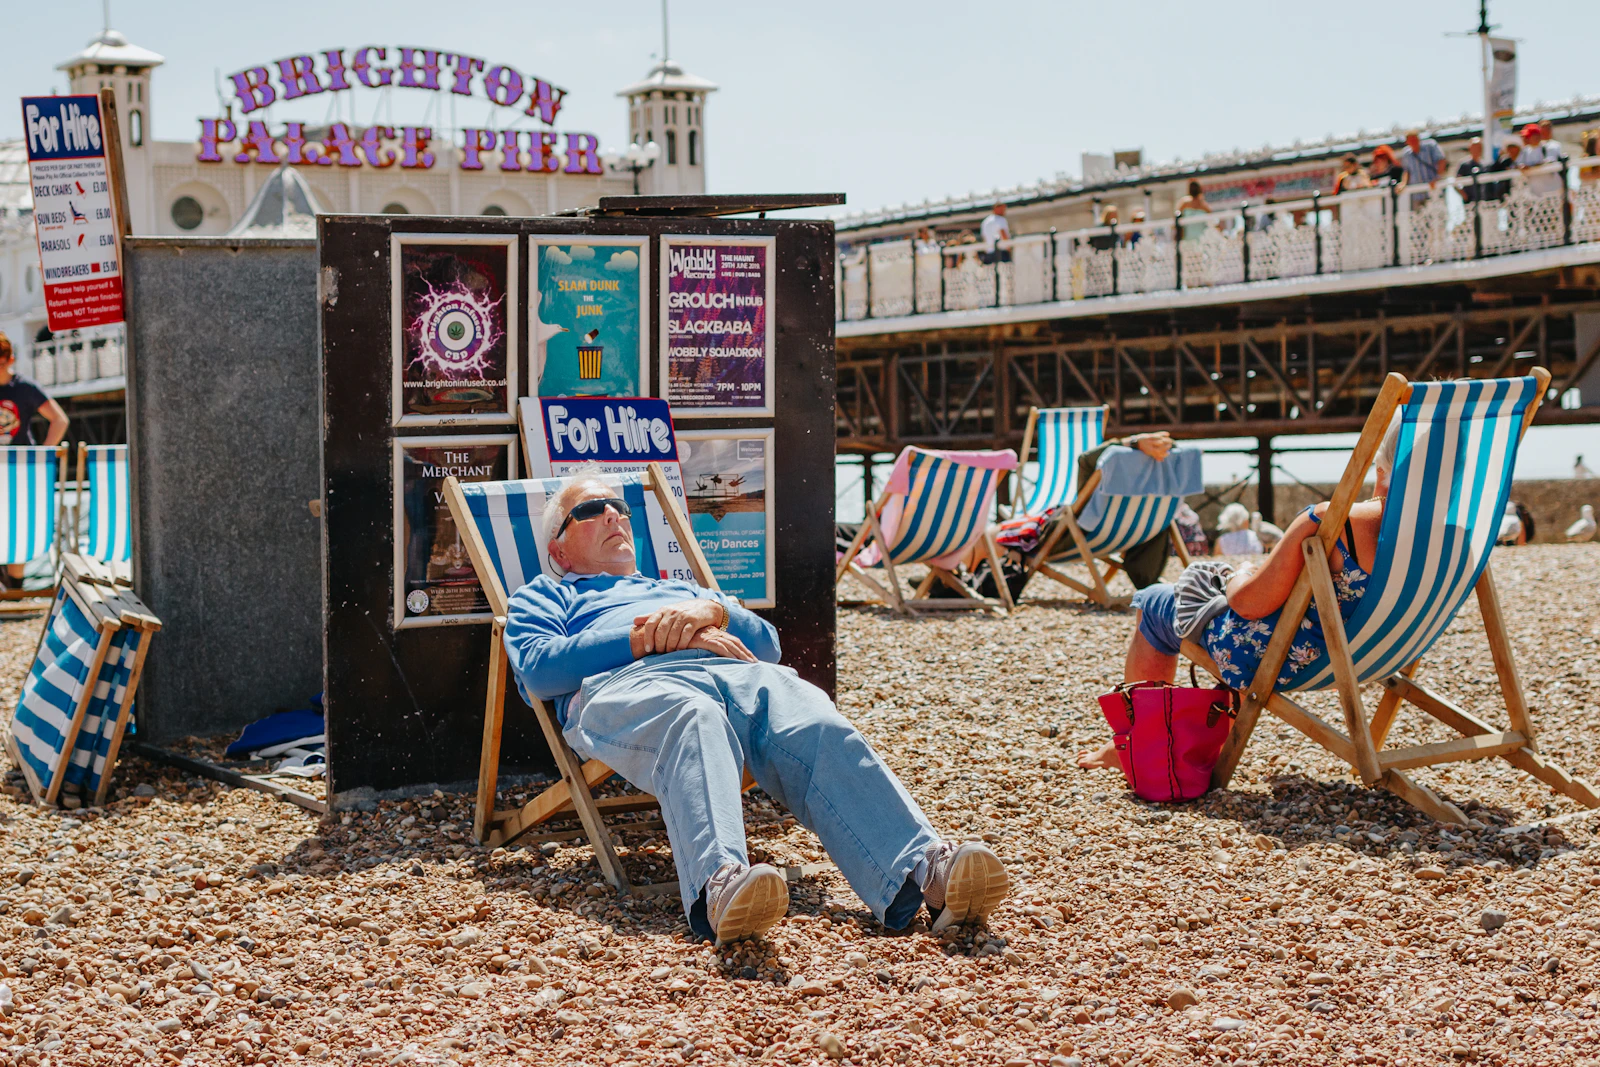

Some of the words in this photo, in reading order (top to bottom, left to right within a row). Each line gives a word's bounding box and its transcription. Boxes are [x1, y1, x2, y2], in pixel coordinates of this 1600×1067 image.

[227, 46, 568, 126] BRIGHTON
[26, 103, 60, 153] For
[60, 102, 102, 151] Hire
[197, 118, 436, 169] PALACE
[461, 127, 604, 174] PIER
[34, 185, 50, 197] DECK
[52, 184, 72, 196] CHAIRS
[93, 181, 108, 193] £3.00
[38, 213, 50, 225] SUN
[51, 212, 67, 223] BEDS
[96, 208, 111, 219] £6.00
[41, 239, 70, 252] PARASOLS
[100, 235, 114, 246] £5.00
[670, 249, 716, 275] Wobbly
[44, 264, 90, 279] WINDBREAKERS
[103, 261, 117, 272] £5.00
[684, 270, 716, 279] Records
[87, 282, 108, 292] yourself
[558, 280, 587, 291] SLAM
[590, 280, 620, 291] DUNK
[668, 292, 735, 309] GROUCH
[736, 296, 744, 306] IN
[745, 296, 763, 306] DUB
[74, 308, 85, 316] NOT
[87, 304, 120, 314] Transferable
[576, 305, 603, 318] JUNK
[429, 304, 459, 339] Brighton
[460, 303, 482, 339] Infused
[668, 320, 752, 334] SLACKBABA
[445, 350, 468, 360] CBD
[668, 347, 708, 357] WOBBLY
[709, 348, 762, 357] SQUADRON
[404, 378, 507, 389] www.brightoninfused.co.uk
[716, 383, 734, 391] 7PM
[741, 383, 761, 391] 10PM
[547, 405, 601, 454] For
[604, 406, 672, 454] Hire
[444, 452, 469, 464] THE
[422, 466, 492, 477] MERCHANT
[668, 542, 682, 553] £5.
[700, 540, 720, 551] City
[722, 539, 759, 548] Dances
[673, 569, 695, 580] £5.0
